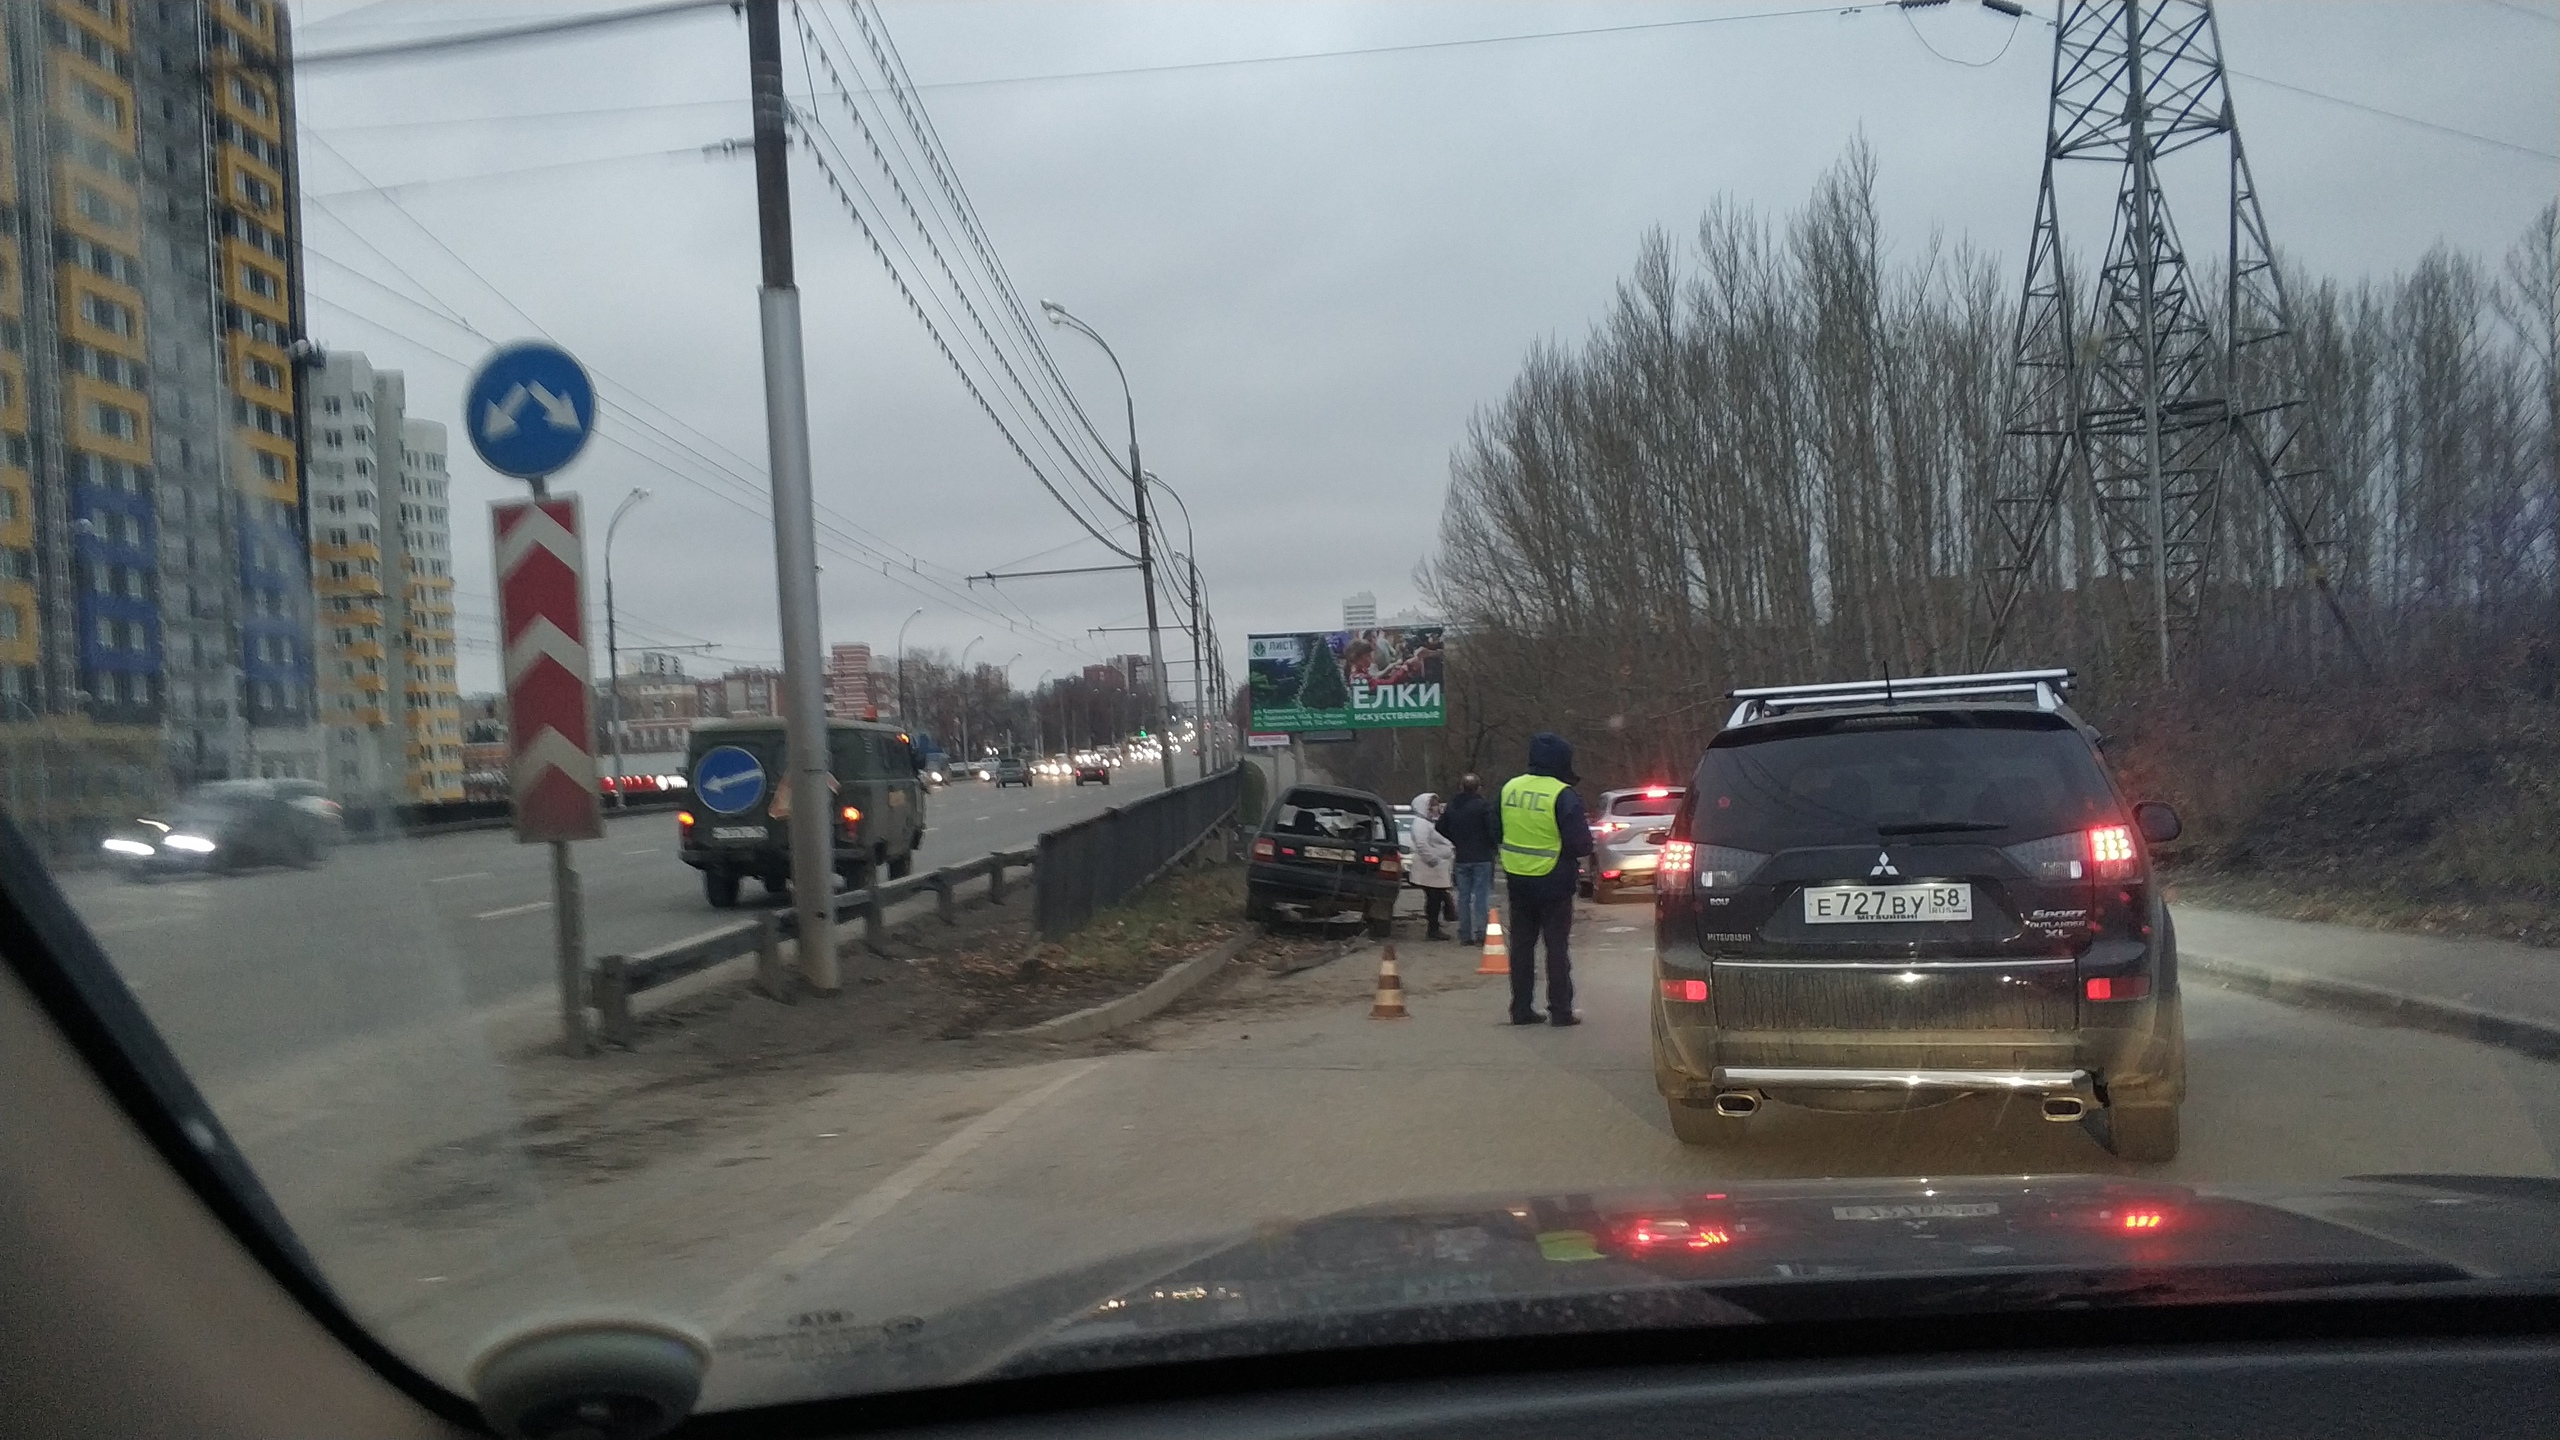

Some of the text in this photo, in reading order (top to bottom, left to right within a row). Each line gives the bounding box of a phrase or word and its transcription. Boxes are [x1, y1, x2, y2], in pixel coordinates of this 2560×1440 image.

[1268, 640, 1293, 651] ЛИСТ
[1353, 679, 1441, 709] ЁЛКИ
[1354, 711, 1441, 722] искусственные
[1504, 788, 1550, 811] ДПС
[1932, 889, 1960, 906] 58
[2029, 920, 2085, 928] OUTLANDER
[1707, 932, 1751, 942] MITSUBISHI
[2044, 928, 2072, 938] XL
